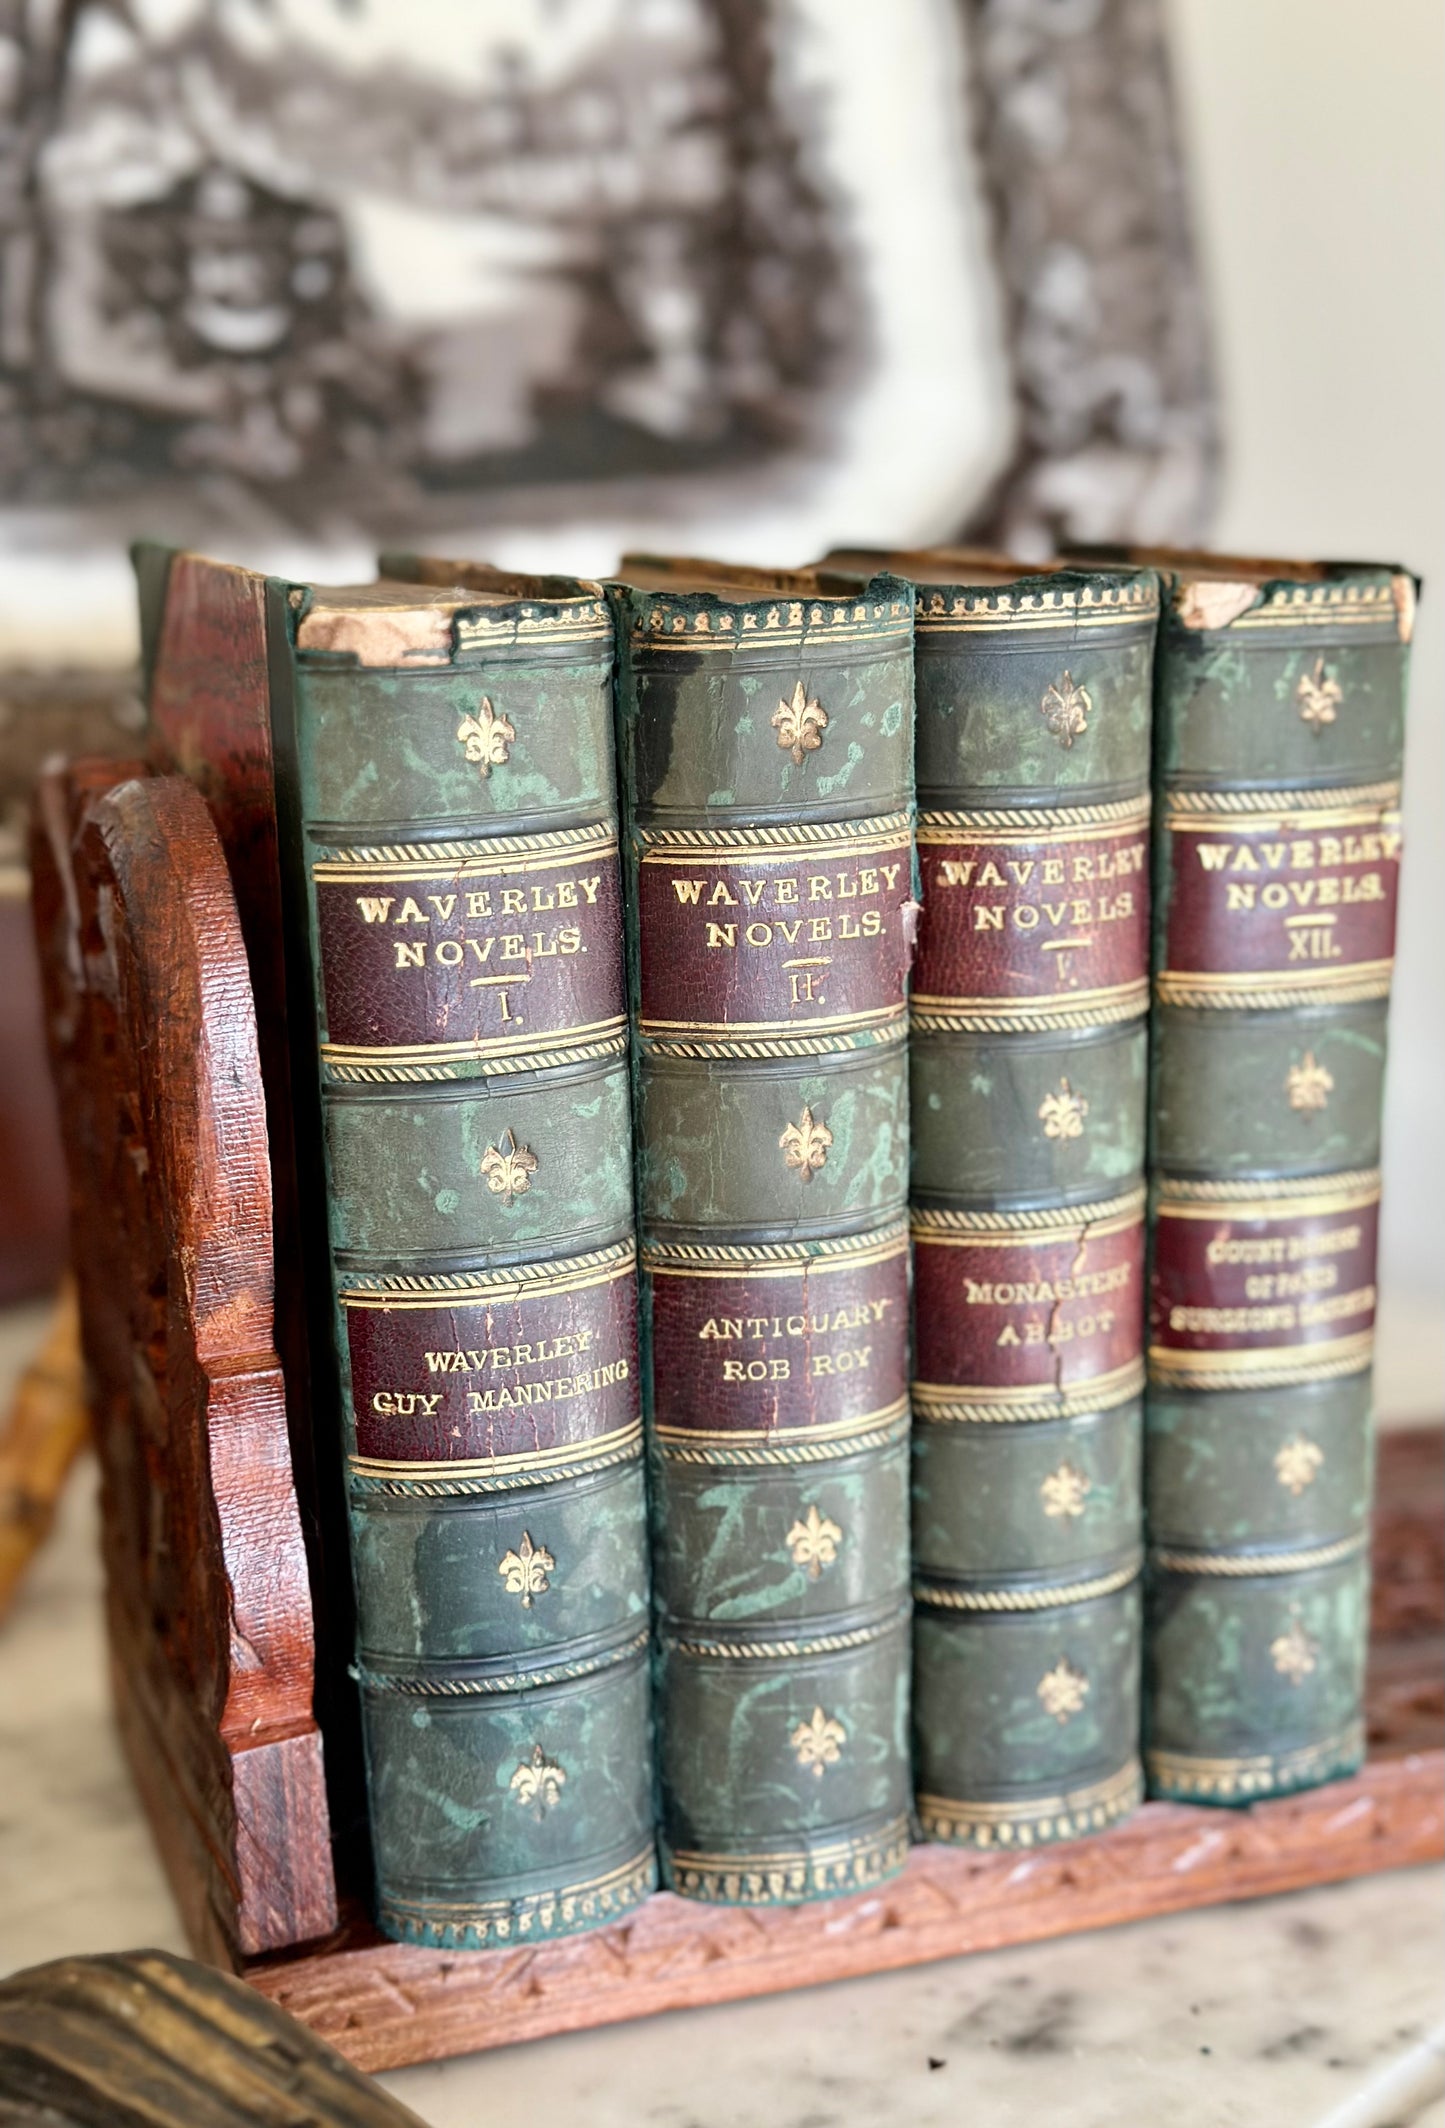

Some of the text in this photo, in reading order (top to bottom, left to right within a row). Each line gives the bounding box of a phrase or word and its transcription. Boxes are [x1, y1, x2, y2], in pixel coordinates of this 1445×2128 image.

[672, 863, 901, 906] WAVERLEY
[941, 843, 1145, 887] WAVERLEY
[356, 876, 601, 924] WAVERLEY
[393, 926, 588, 968] NOVELS.
[706, 911, 887, 948] NOVELS.
[1288, 929, 1342, 961] XII.
[497, 991, 524, 1025] I.
[789, 973, 826, 1005] II.
[699, 1299, 893, 1340] ANTIQUARY
[425, 1331, 593, 1373] WAVERLEY
[723, 1346, 872, 1382] ROB ROY
[373, 1359, 630, 1416] GUY MANNERING
